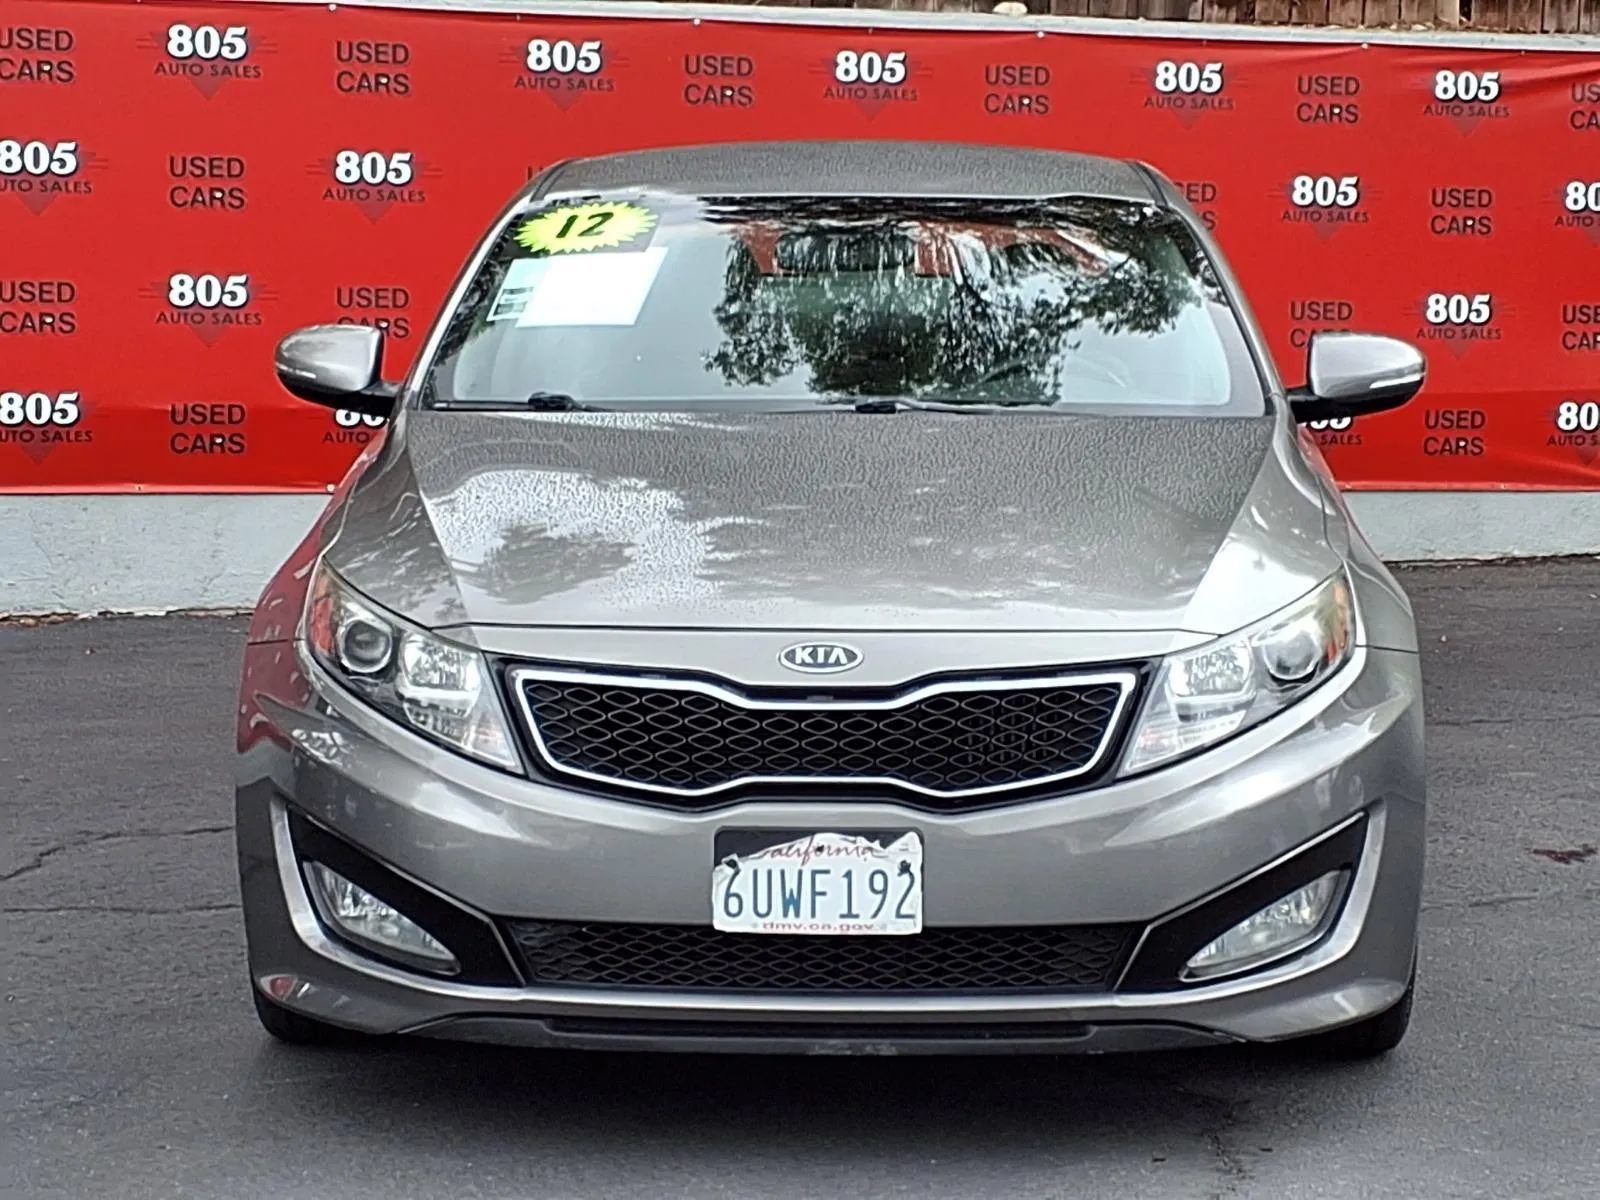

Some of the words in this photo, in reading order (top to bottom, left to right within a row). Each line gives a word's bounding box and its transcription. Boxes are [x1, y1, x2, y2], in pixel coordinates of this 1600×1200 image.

[0, 28, 73, 51] USED
[167, 23, 247, 60] 805
[337, 41, 409, 65] USED
[526, 38, 601, 73] 805
[0, 58, 74, 83] CARS
[155, 62, 203, 77] AUTO
[210, 62, 260, 78] SALES
[685, 55, 753, 77] USED
[835, 50, 906, 84] 805
[986, 66, 1050, 86] USED
[1154, 60, 1223, 93] 805
[337, 71, 410, 95] CARS
[516, 76, 560, 90] AUTO
[565, 76, 614, 92] SALES
[826, 85, 867, 99] AUTO
[871, 85, 917, 101] SALES
[1298, 76, 1360, 96] USED
[1434, 69, 1499, 101] 805
[1572, 82, 1600, 103] US
[685, 84, 752, 106] CARS
[985, 93, 1049, 115] CARS
[1145, 95, 1186, 108] AUTO
[1191, 97, 1232, 110] SALES
[1297, 103, 1358, 124] CARS
[1424, 103, 1464, 117] AUTO
[1466, 103, 1509, 118] SALES
[1570, 110, 1600, 130] CA
[0, 139, 77, 175] 805
[170, 156, 244, 179] USED
[335, 150, 412, 185] 805
[0, 178, 33, 192] UTO
[40, 180, 92, 194] SALES
[324, 187, 370, 201] AUTO
[377, 189, 425, 203] SALES
[1174, 182, 1216, 202] ED
[1291, 175, 1358, 207] 805
[1565, 181, 1600, 212] 80
[170, 186, 245, 209] CARS
[1432, 188, 1492, 208] USED
[555, 212, 614, 238] 12
[1283, 208, 1323, 222] AUTO
[1326, 208, 1369, 223] SALES
[1431, 215, 1491, 235] CARS
[1555, 215, 1594, 227] AUTO
[0, 281, 75, 303] USED
[168, 273, 248, 307] 805
[337, 287, 409, 309] USED
[157, 310, 206, 325] AUTO
[211, 310, 261, 325] SALES
[1291, 301, 1352, 321] USED
[1425, 293, 1490, 324] 805
[1563, 305, 1600, 324] USE
[0, 311, 76, 334] CARS
[1417, 328, 1456, 340] AUTO
[1461, 327, 1502, 341] SALES
[1562, 331, 1600, 350] CAR
[0, 391, 79, 425] 805
[171, 404, 245, 425] USED
[1557, 401, 1600, 431] 80
[1425, 410, 1485, 429] USED
[0, 430, 34, 442] UTO
[41, 430, 92, 443] SALES
[170, 433, 245, 454] CARS
[324, 431, 369, 444] AUTO
[1320, 434, 1361, 445] SALES
[1424, 437, 1483, 456] CARS
[1548, 434, 1586, 446] AUTO
[795, 647, 848, 665] KIA
[723, 866, 916, 919] 6UWF192
[762, 920, 874, 931] dmv.ca.gov
